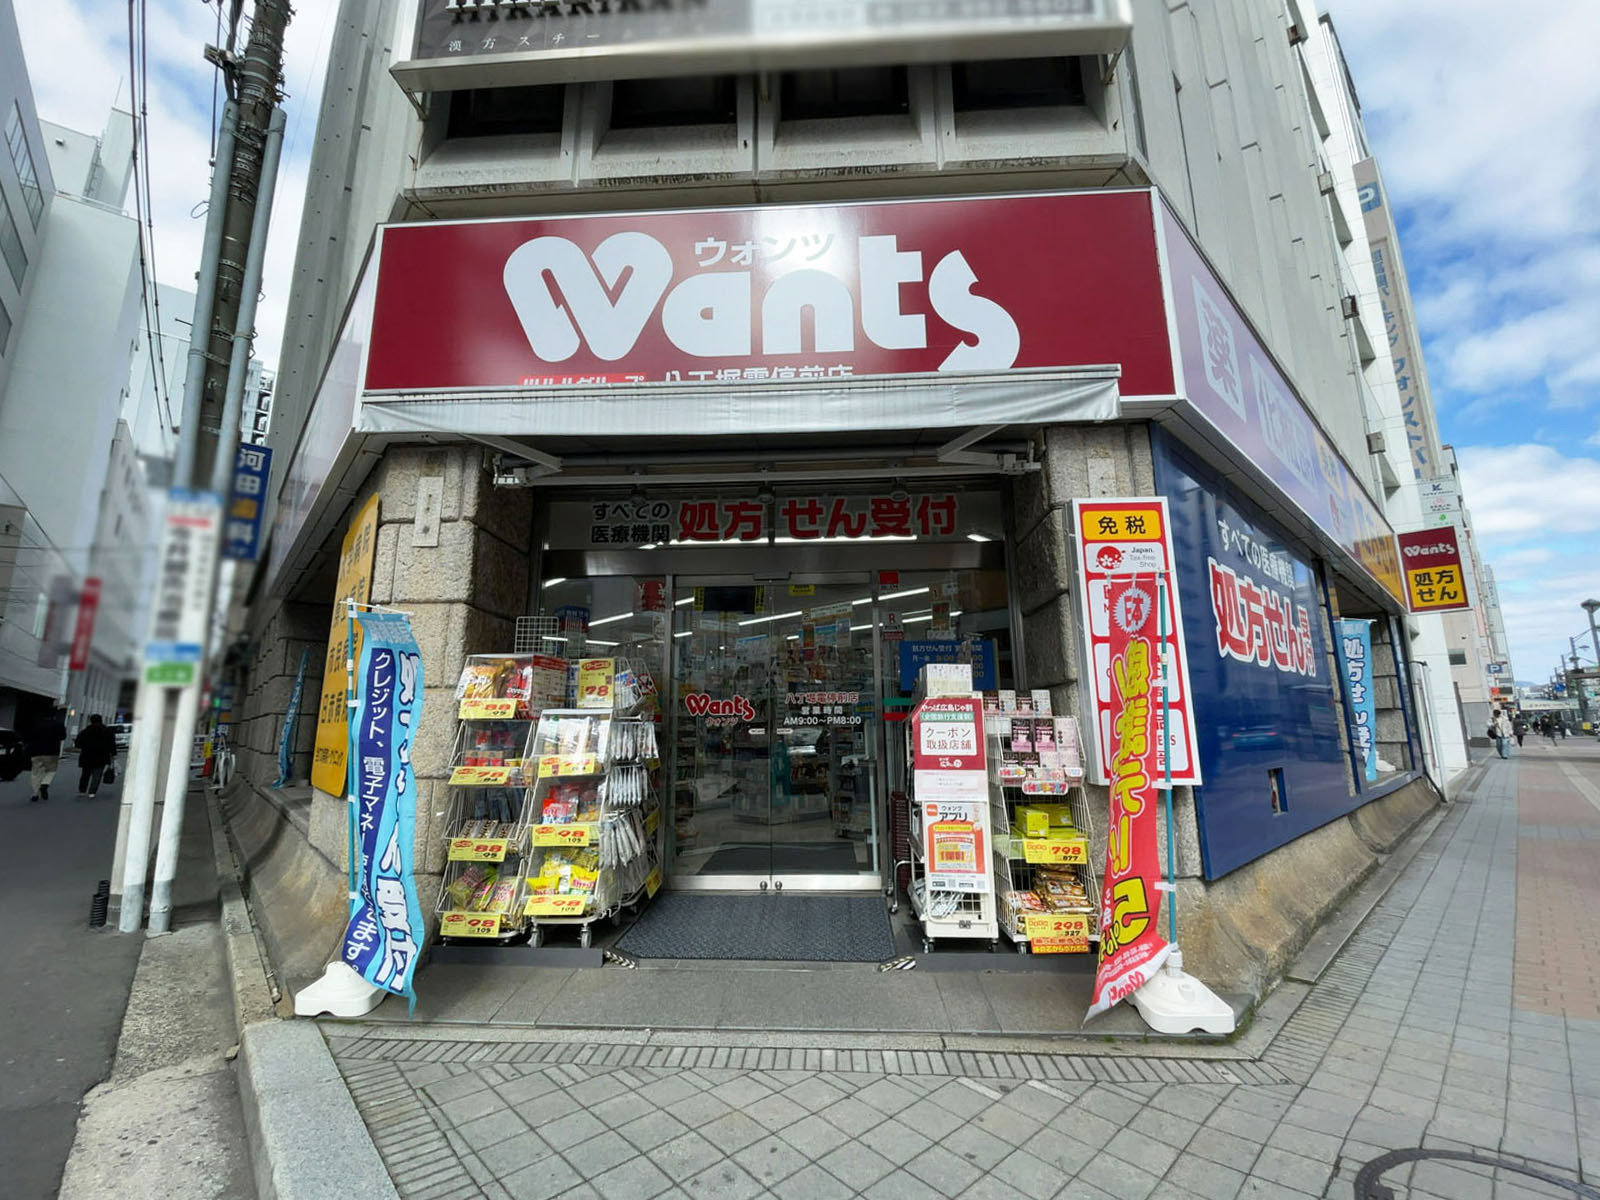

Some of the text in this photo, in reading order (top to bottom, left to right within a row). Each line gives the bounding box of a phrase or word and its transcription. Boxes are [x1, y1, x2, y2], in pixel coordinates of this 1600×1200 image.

[694, 233, 835, 267] ウォンツ
[503, 231, 1020, 371] Wants
[592, 501, 670, 519] すべての
[1098, 515, 1146, 535] 免税
[591, 524, 670, 544] 医療機関
[1403, 543, 1456, 558] Wants
[1414, 569, 1455, 587] 処方
[1416, 586, 1458, 603] せん
[1490, 664, 1501, 673] P
[685, 692, 756, 721] Wants
[801, 705, 844, 715] 営業時間
[926, 727, 971, 738] クーポン
[926, 739, 972, 751] 取扱店舗
[938, 811, 968, 823] アプリ
[1051, 846, 1082, 855] 798
[1053, 921, 1084, 931] 298
